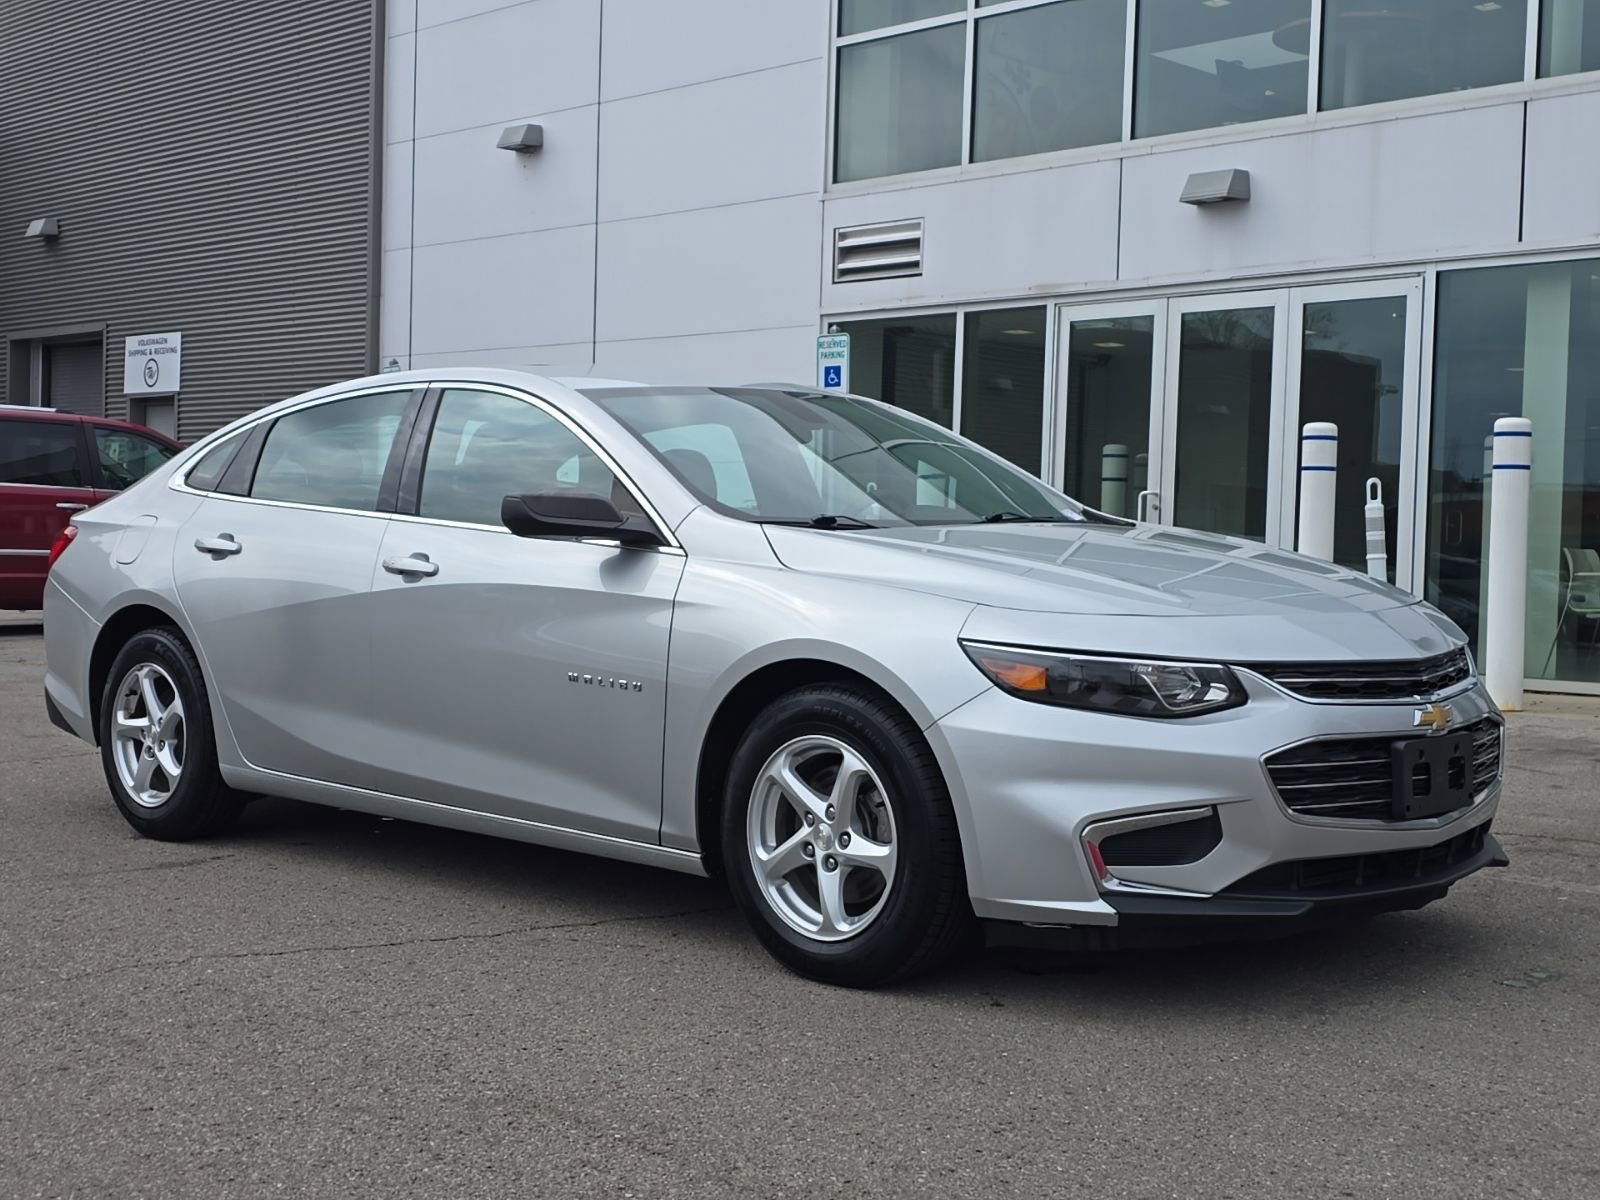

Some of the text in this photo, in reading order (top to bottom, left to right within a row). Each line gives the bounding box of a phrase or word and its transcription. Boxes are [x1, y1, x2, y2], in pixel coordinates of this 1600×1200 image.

[818, 339, 848, 349] RESERVED
[820, 350, 846, 360] PARKING
[567, 672, 642, 693] MALIBU
